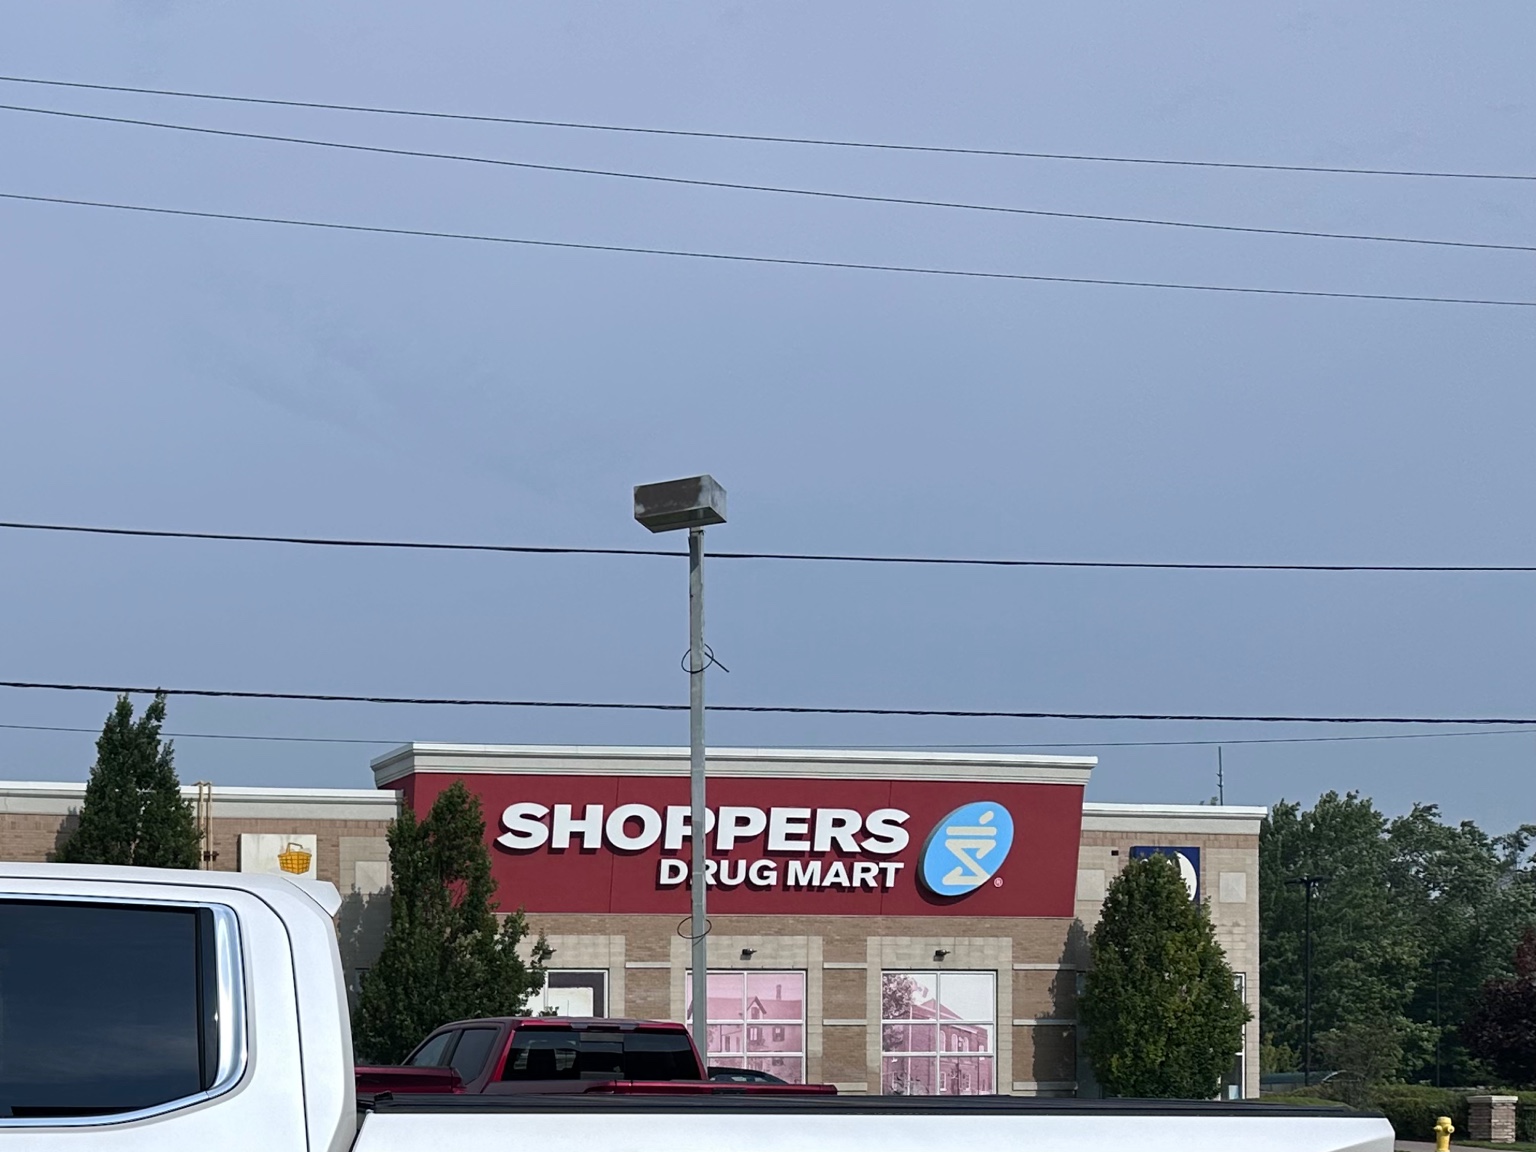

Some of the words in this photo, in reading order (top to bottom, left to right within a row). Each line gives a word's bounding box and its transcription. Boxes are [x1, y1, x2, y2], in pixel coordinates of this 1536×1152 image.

[497, 802, 910, 854] SHOPPERS
[659, 858, 777, 886] DRUG
[787, 859, 904, 888] MART
